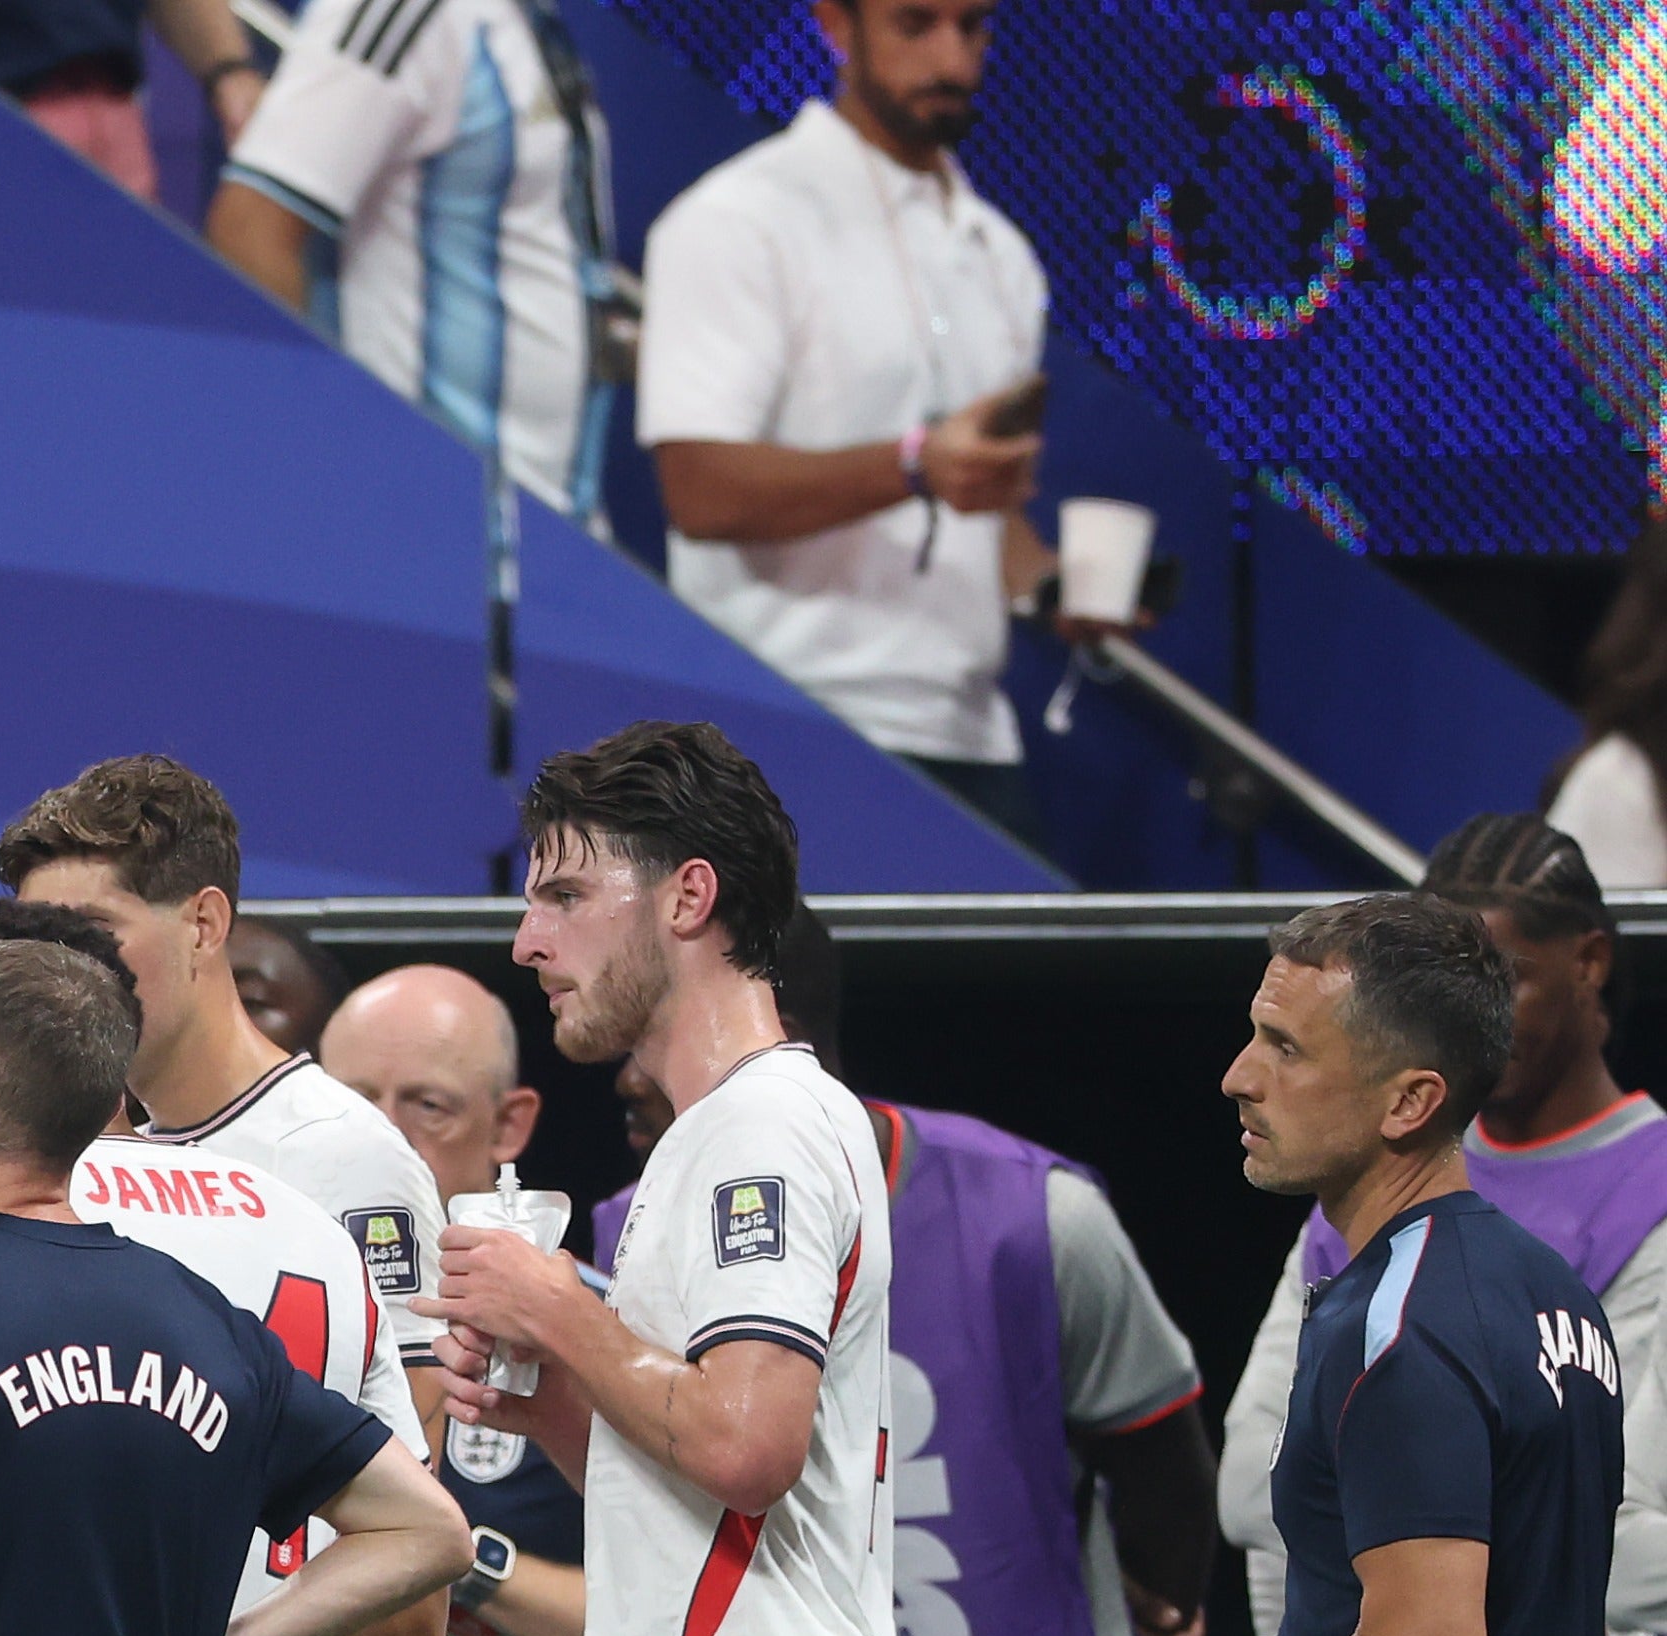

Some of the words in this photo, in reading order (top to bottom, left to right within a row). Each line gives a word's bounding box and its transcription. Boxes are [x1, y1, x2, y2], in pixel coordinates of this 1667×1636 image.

[83, 1161, 266, 1219] JAMES
[725, 1228, 775, 1250] EDUCATION
[372, 1261, 410, 1277] UCATION
